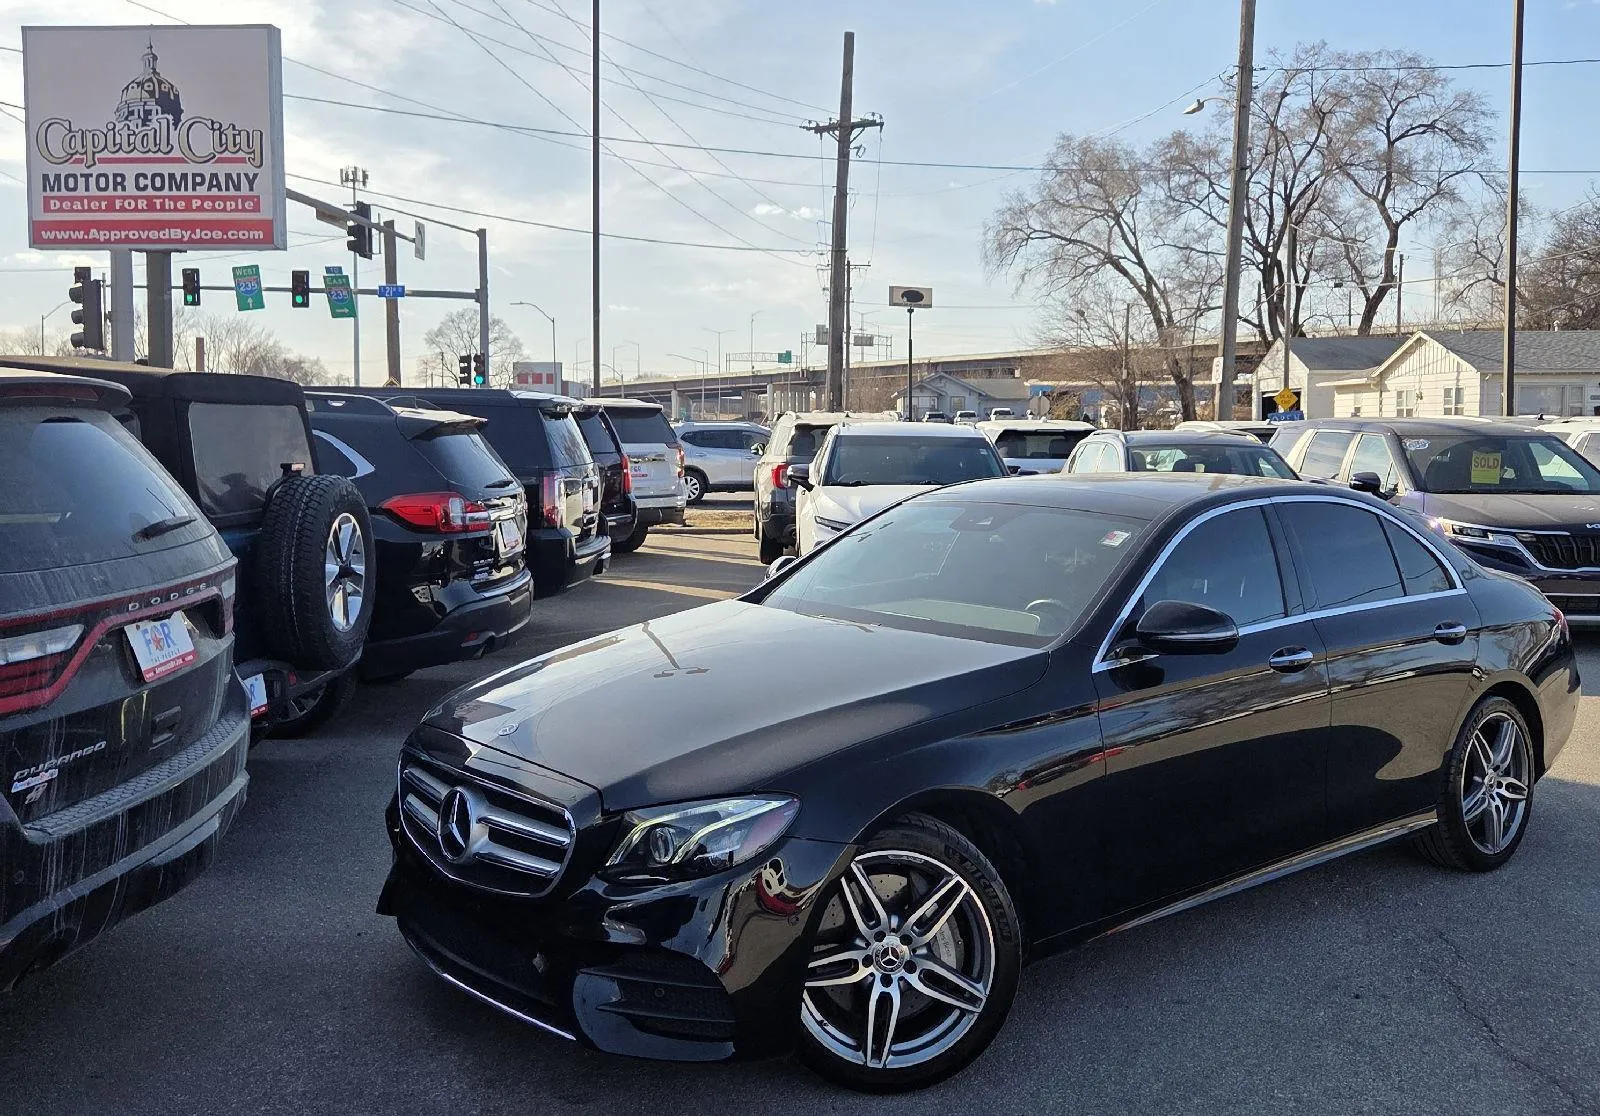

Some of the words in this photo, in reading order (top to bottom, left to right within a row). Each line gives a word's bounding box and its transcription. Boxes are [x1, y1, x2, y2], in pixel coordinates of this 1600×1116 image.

[36, 117, 174, 169] Capital
[178, 116, 264, 169] City
[42, 173, 127, 192] MOTOR
[134, 172, 260, 192] COMPANY
[50, 199, 108, 211] Dealer
[115, 199, 149, 211] FOR
[154, 199, 186, 211] The
[41, 227, 264, 242] www.ApprovedByJoe.com
[235, 267, 258, 276] WEST
[240, 282, 258, 291] 235
[326, 277, 348, 285] EAST
[331, 290, 349, 300] 235
[1473, 455, 1500, 470] SOLD
[128, 582, 207, 611] DODGE
[140, 622, 176, 655] FOR
[13, 740, 107, 781] DURANGO
